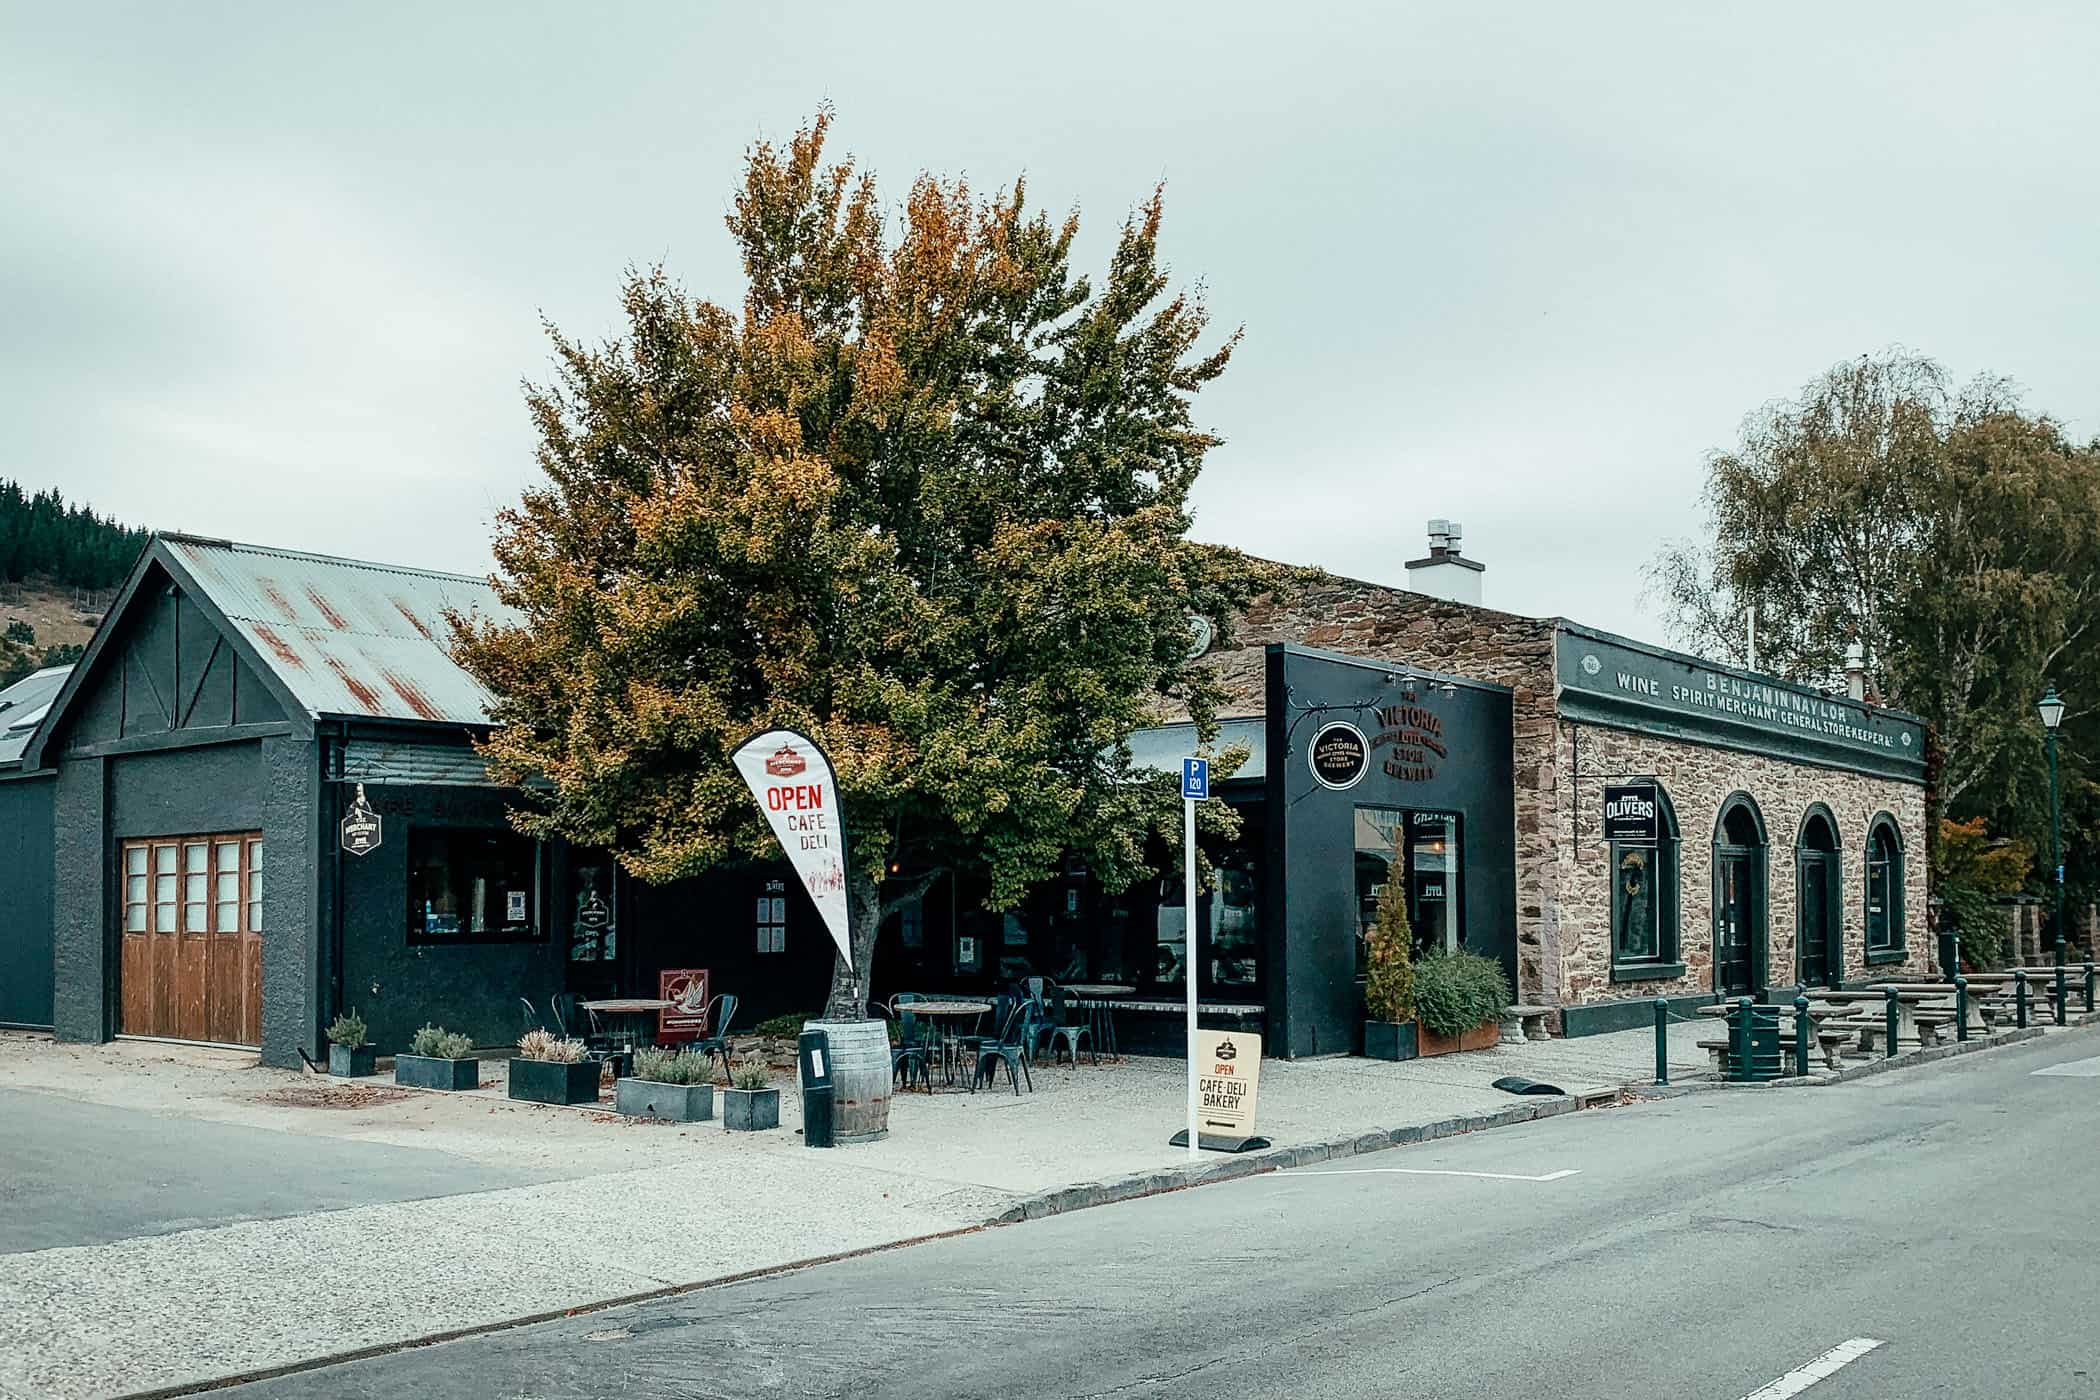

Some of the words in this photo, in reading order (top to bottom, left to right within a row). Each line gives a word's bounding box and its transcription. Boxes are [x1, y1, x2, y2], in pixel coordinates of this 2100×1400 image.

[1616, 671, 1659, 696] WINE
[1672, 685, 1714, 707] SPIRIT
[1781, 711, 1821, 732] GENERAL
[1706, 673, 1788, 708] BENJAMIN
[1792, 695, 1847, 723] NAYLOR
[1377, 704, 1442, 737] VICTORIA
[1319, 742, 1359, 753] VICTORIA
[1191, 760, 1200, 776] P
[1190, 777, 1201, 790] 120
[767, 784, 822, 811] OPEN
[1606, 801, 1654, 819] OLIVERS
[788, 813, 826, 831] CAFE
[801, 834, 828, 850] DELI
[1214, 1063, 1235, 1076] OPEN
[1203, 1093, 1241, 1110] BAKERY
